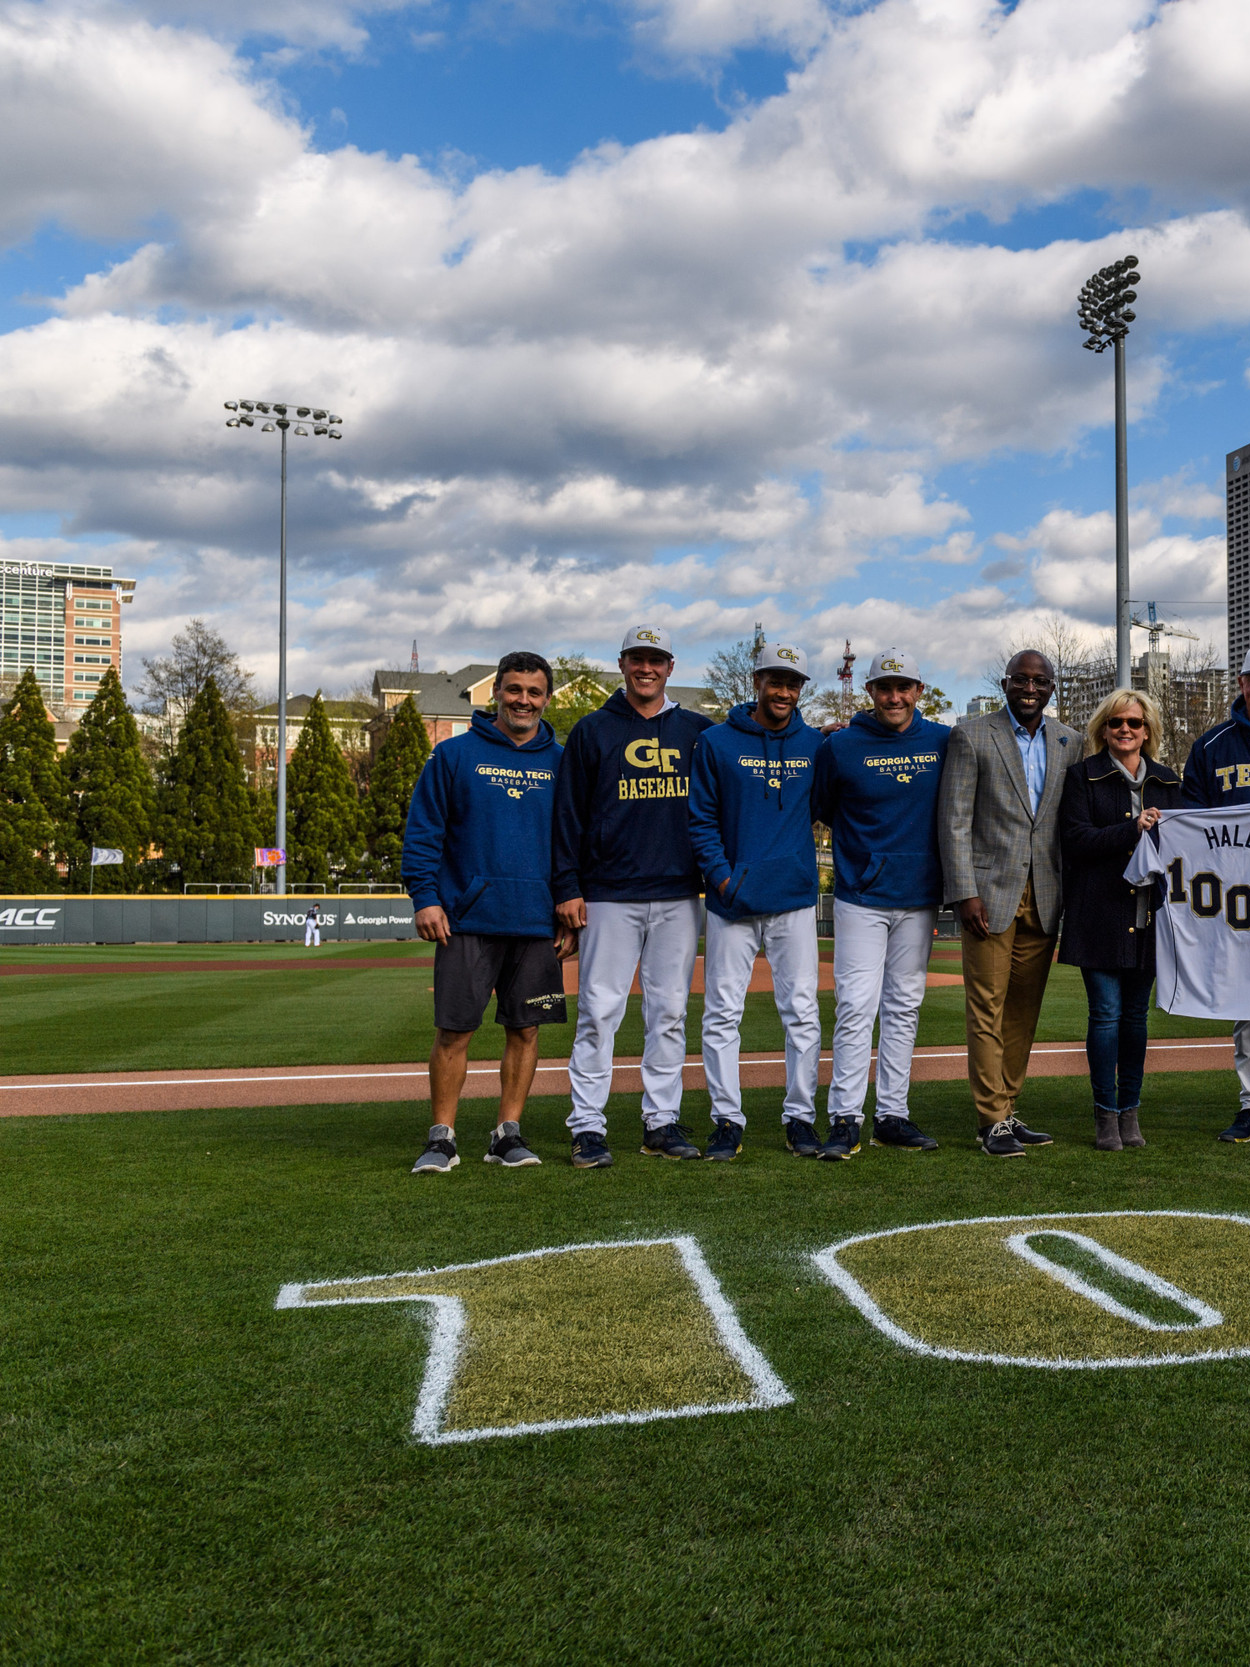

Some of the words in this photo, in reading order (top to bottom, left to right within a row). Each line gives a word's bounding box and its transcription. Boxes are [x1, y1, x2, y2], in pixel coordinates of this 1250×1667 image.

[0, 563, 53, 577] ccenture
[624, 738, 681, 773] GT
[866, 757, 911, 767] GEORGIA
[913, 755, 937, 764] TECH
[785, 760, 808, 768] TECH
[880, 764, 927, 772] BASEBALL
[478, 767, 523, 778] GEORGIA
[525, 771, 551, 780] TECH
[896, 773, 912, 783] GT
[491, 776, 539, 786] BASEBALL
[507, 788, 523, 799] GT
[0, 908, 61, 926] ACC
[263, 911, 335, 926] SYNOUS
[357, 916, 388, 926] Georgia
[388, 916, 413, 924] Power
